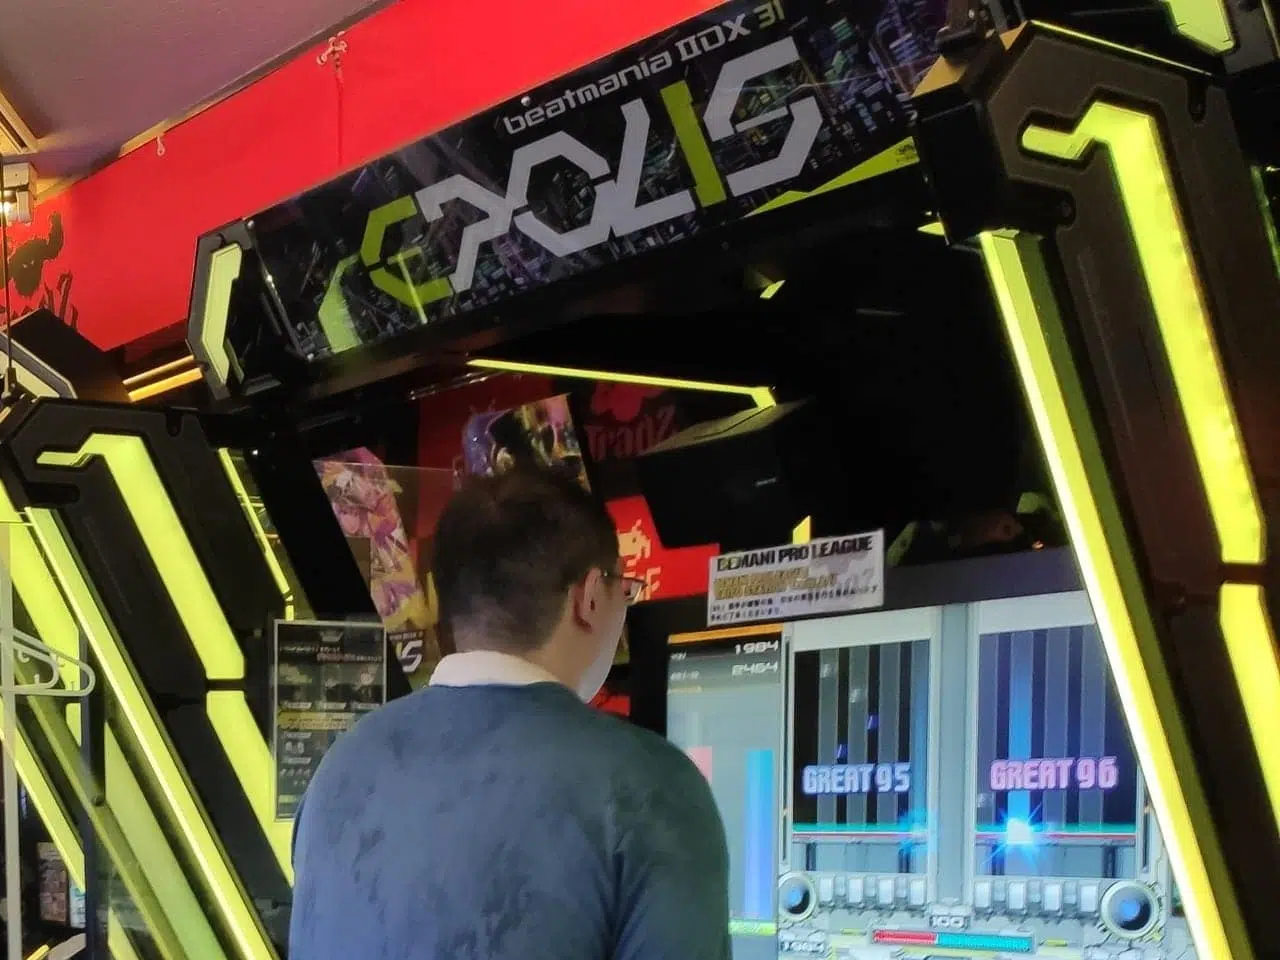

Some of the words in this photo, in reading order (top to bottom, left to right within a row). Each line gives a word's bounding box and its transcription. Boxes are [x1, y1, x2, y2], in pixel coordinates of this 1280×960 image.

[503, 51, 673, 135] beatmania
[755, 0, 784, 30] 31
[779, 546, 810, 564] PRO
[811, 536, 873, 561] LEAGUE
[803, 763, 875, 795] GREAT
[875, 761, 912, 793] 95
[990, 757, 1074, 791] GREAT
[1076, 756, 1118, 789] 96
